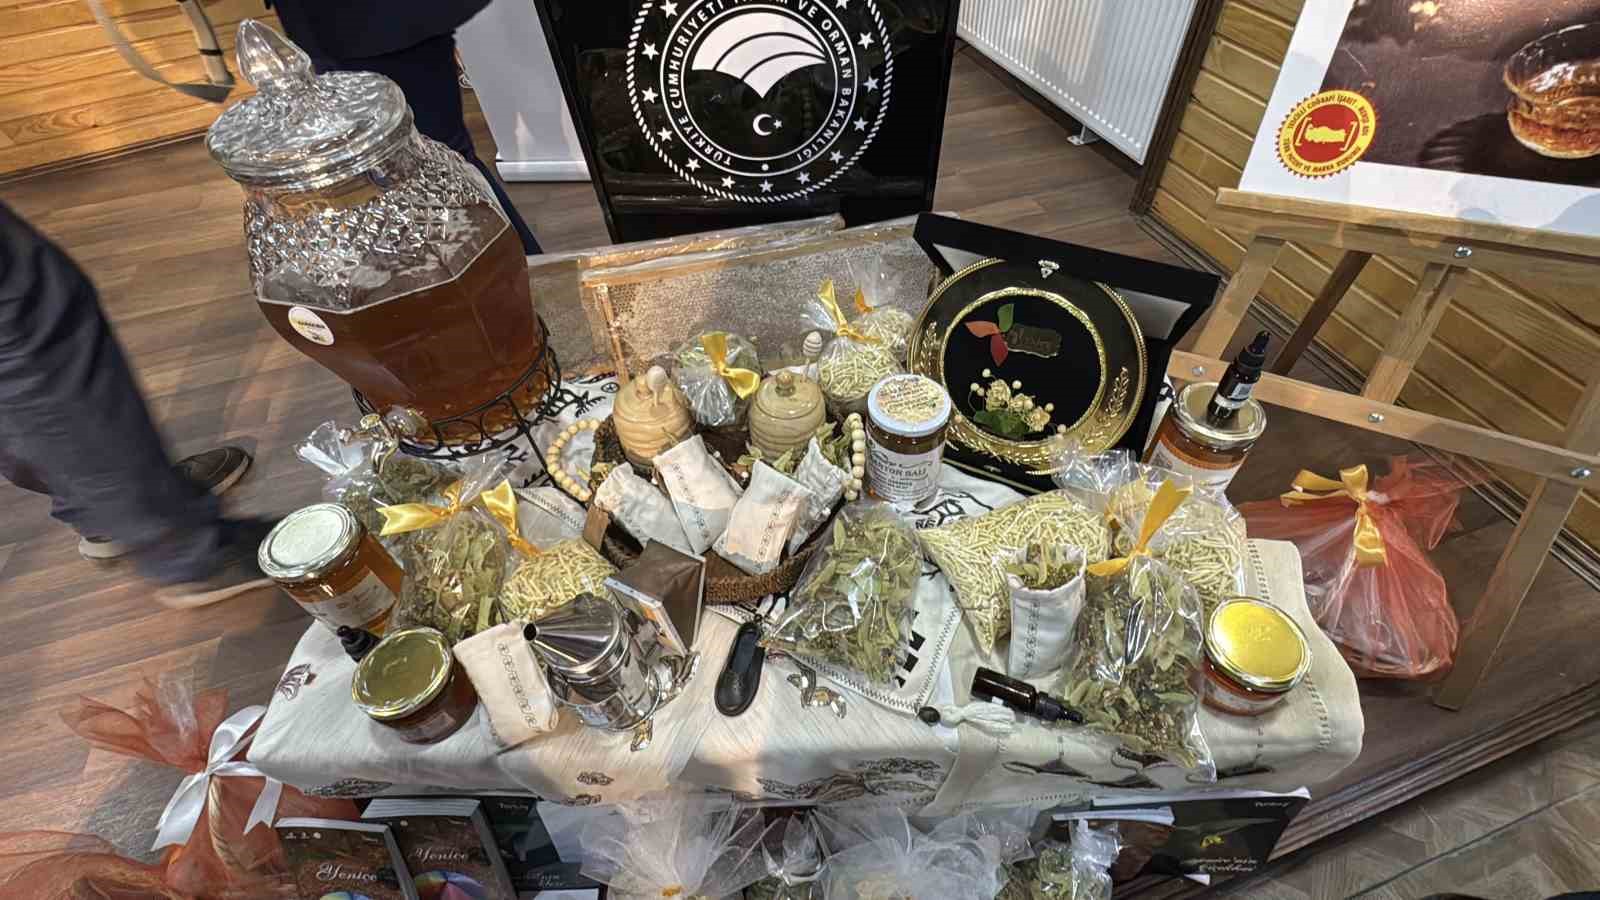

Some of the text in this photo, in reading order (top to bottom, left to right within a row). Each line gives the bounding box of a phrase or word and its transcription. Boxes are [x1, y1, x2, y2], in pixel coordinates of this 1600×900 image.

[797, 0, 818, 19] VE
[821, 19, 853, 80] ORMAN
[676, 115, 732, 167] TÜRKİYE
[796, 87, 853, 162] BAKANLIĞI
[315, 862, 379, 882] Yenice
